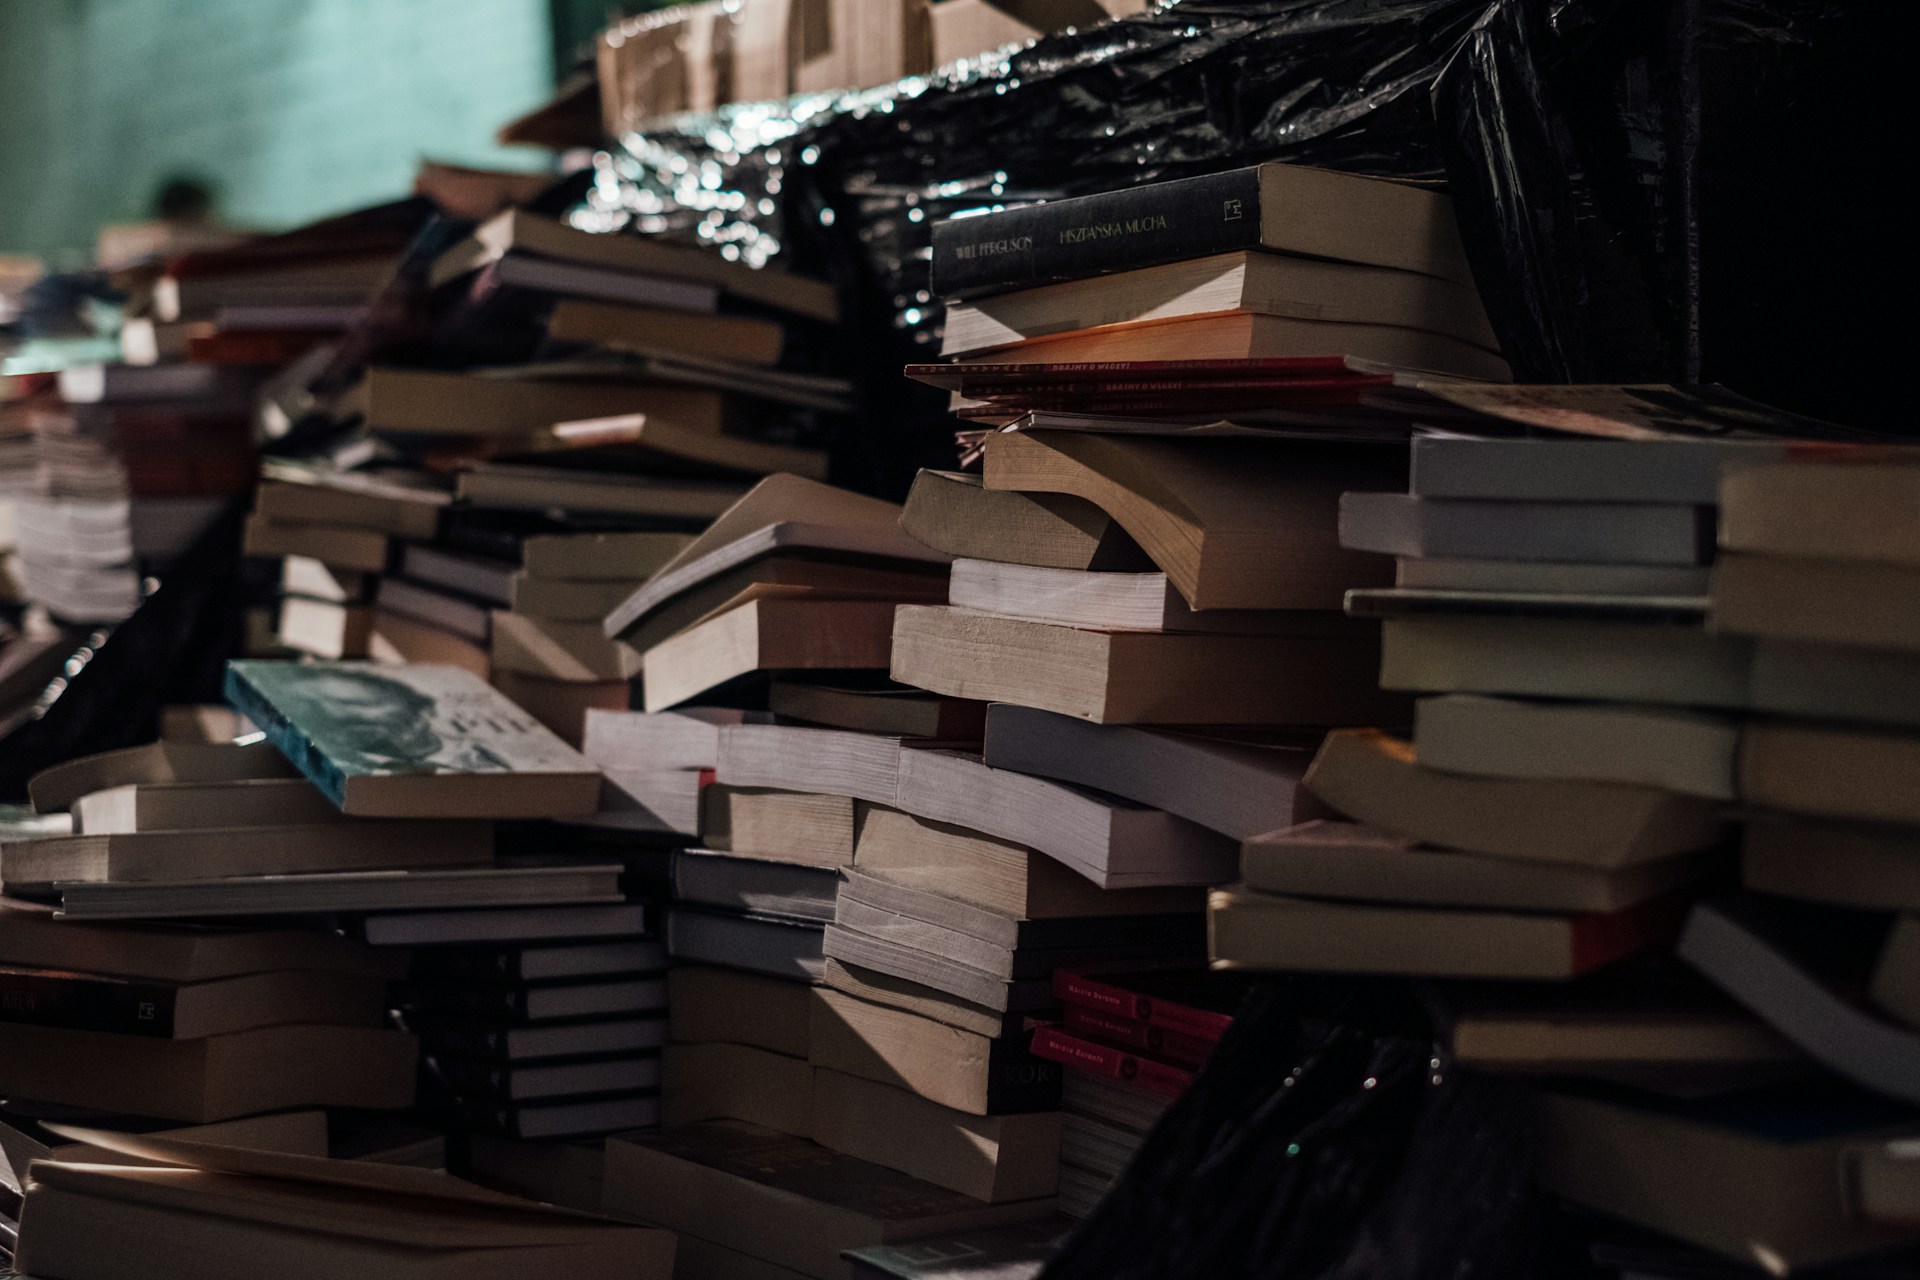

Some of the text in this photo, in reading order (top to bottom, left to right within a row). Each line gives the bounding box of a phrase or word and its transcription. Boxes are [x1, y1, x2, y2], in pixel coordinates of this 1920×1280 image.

[1059, 215, 1167, 245] HISZPAŃSKA MUCHA
[955, 236, 1033, 261] WILL FERGUSON
